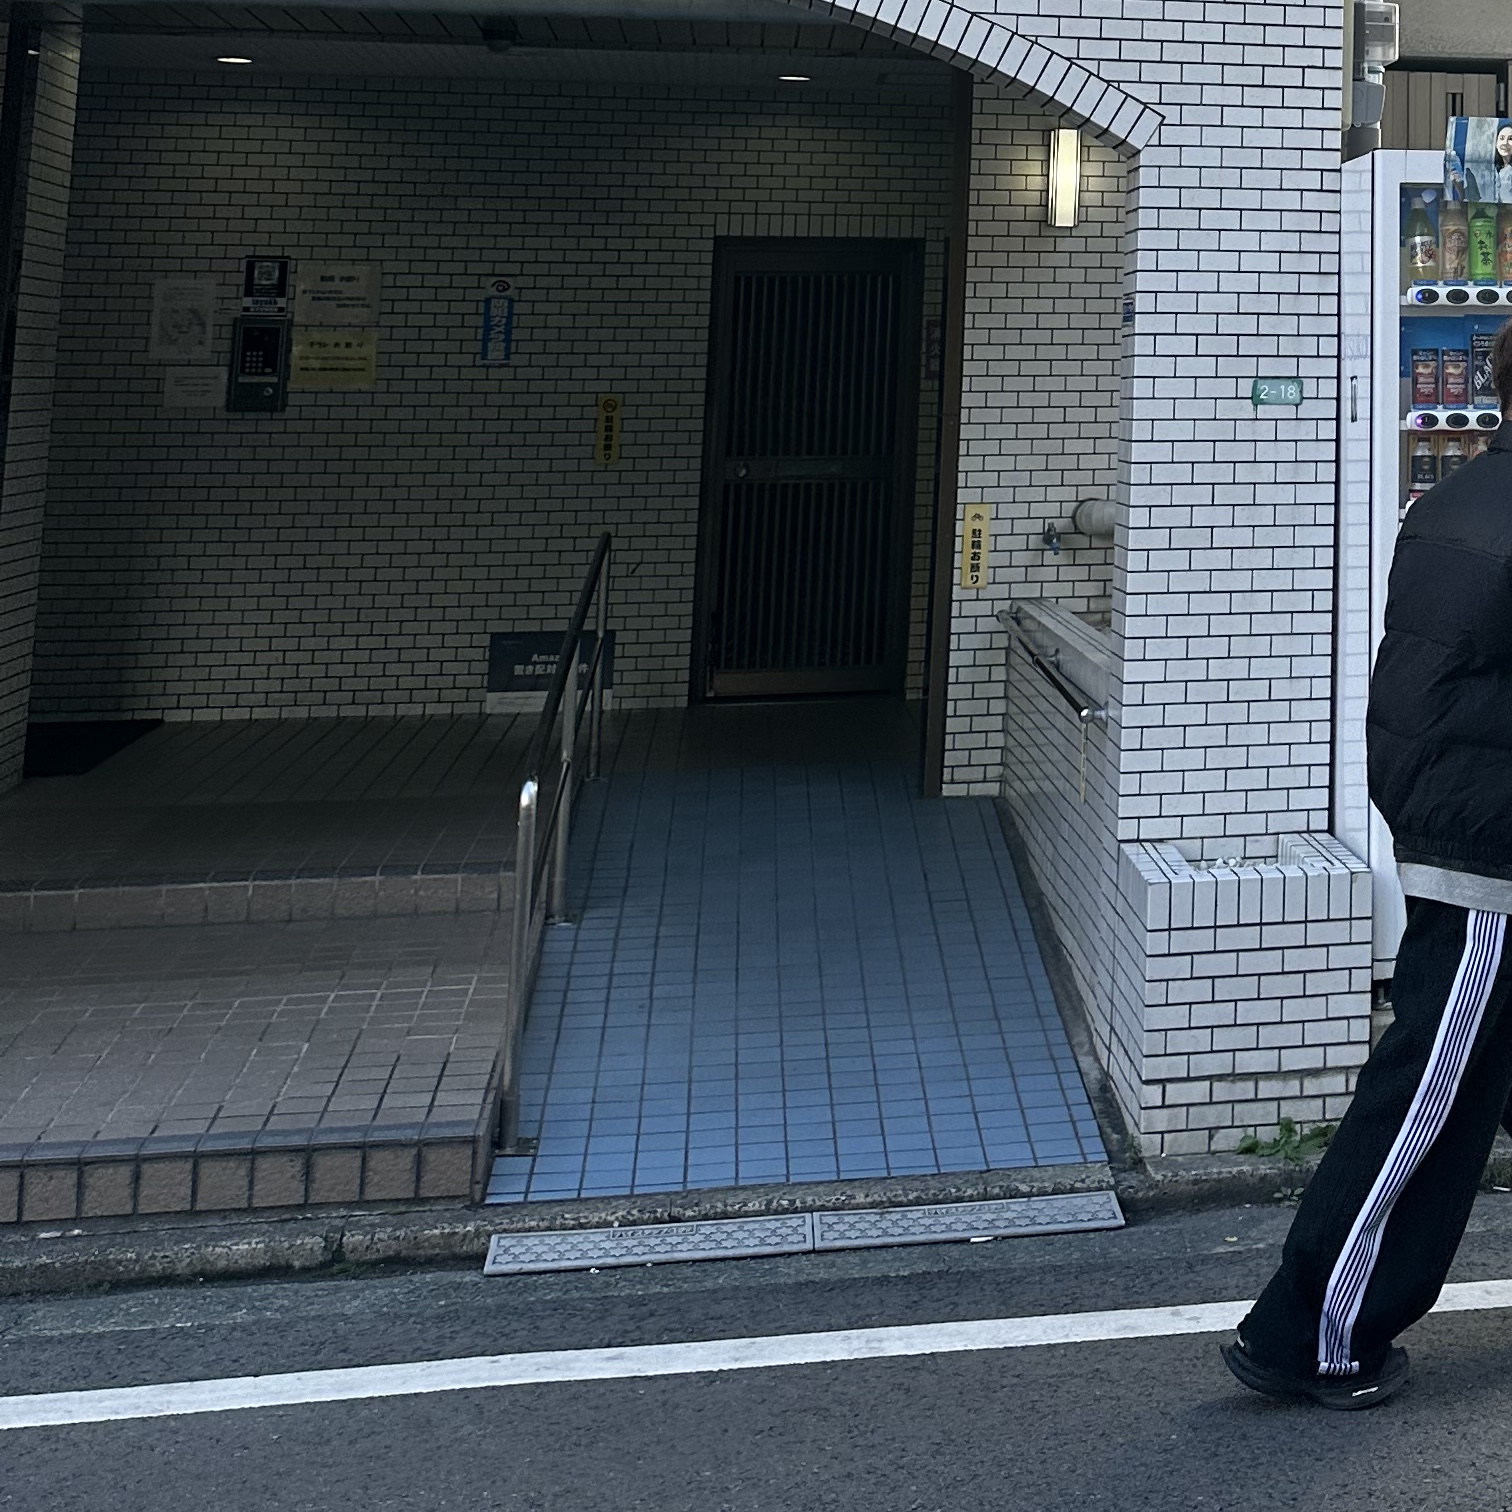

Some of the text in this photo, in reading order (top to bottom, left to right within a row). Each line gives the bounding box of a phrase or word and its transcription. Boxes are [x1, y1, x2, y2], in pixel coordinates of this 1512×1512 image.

[1259, 384, 1296, 400] 2-18
[970, 527, 983, 585] 駐輪お断り
[513, 663, 590, 676] 置き配対件
